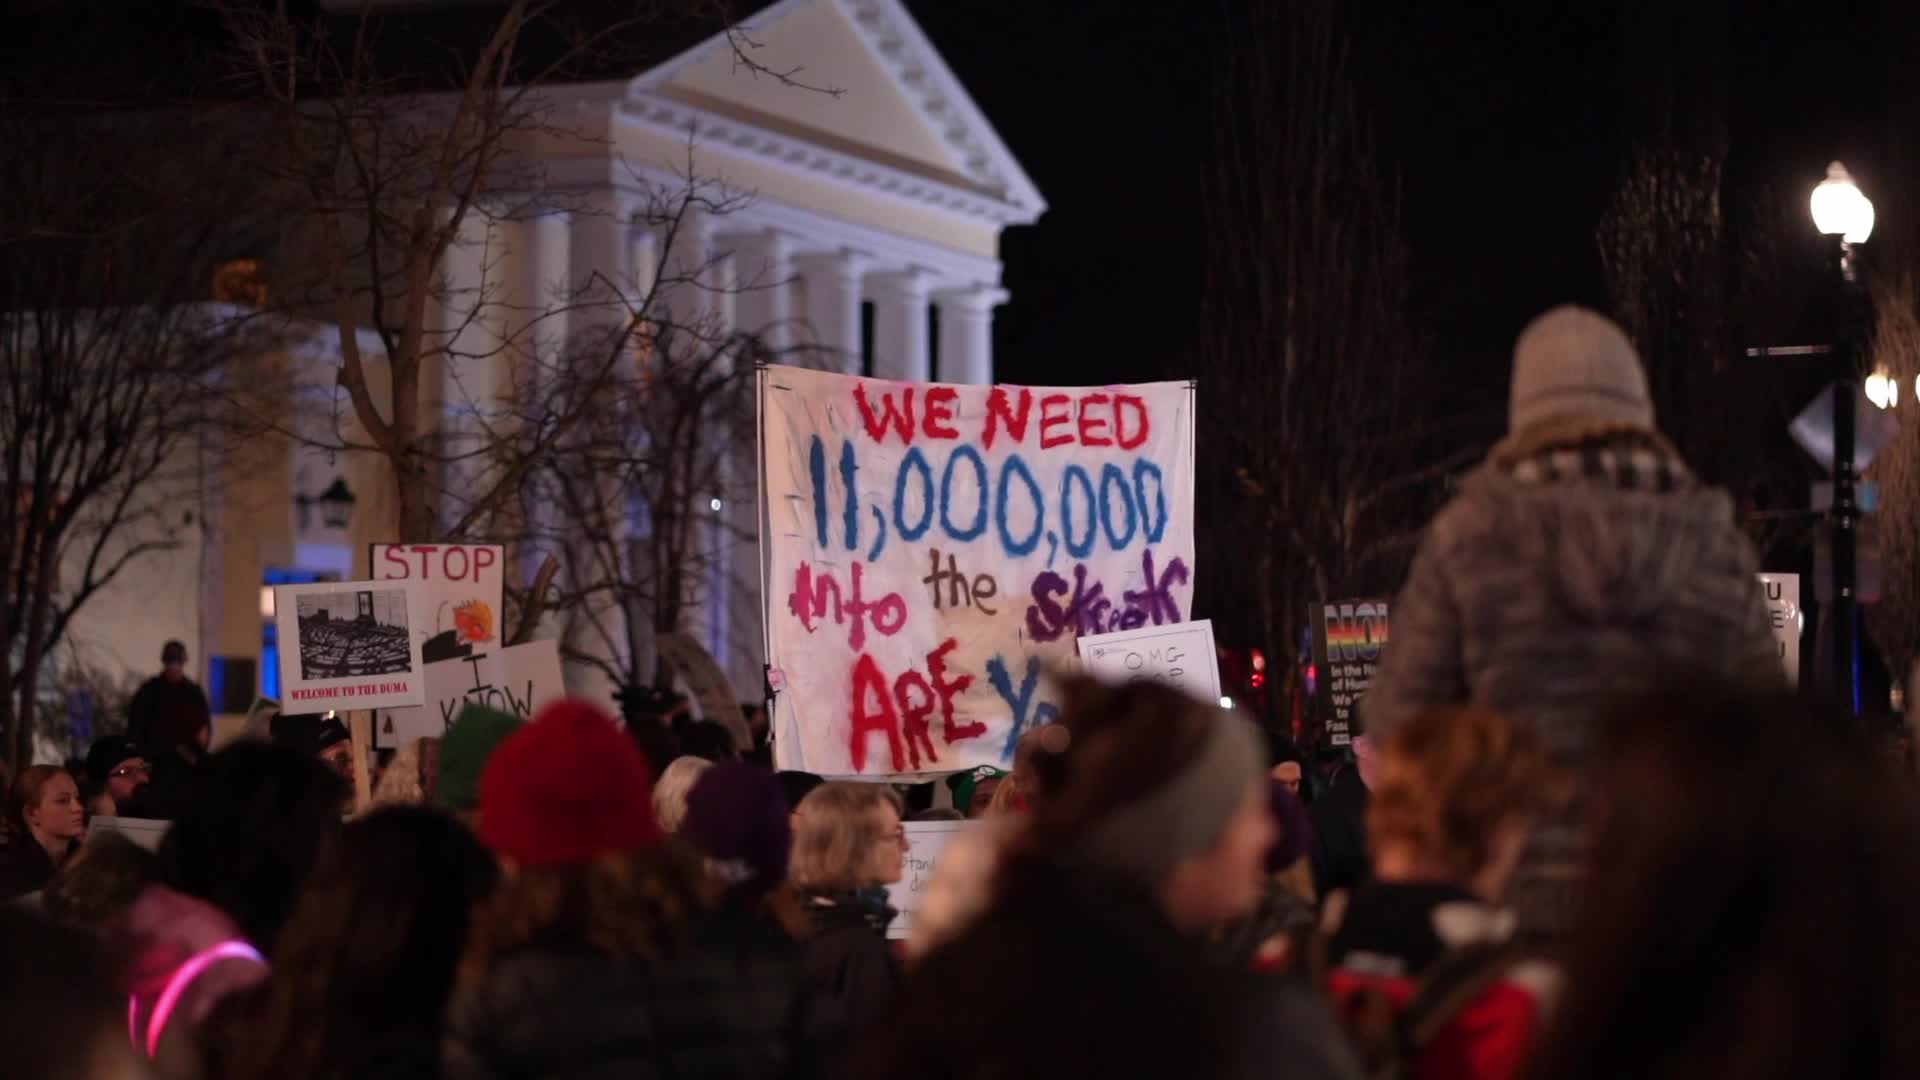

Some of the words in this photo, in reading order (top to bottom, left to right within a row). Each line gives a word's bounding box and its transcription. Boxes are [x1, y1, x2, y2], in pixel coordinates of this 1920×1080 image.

[853, 383, 960, 446] WE
[981, 386, 1149, 451] NEED
[809, 434, 1168, 569] 11,000,000
[385, 543, 494, 583] STOP
[924, 548, 998, 615] the
[462, 652, 493, 694] I
[1124, 646, 1185, 670] OMG
[291, 687, 339, 700] WELCOME
[342, 685, 355, 697] TO
[358, 684, 378, 696] THE
[380, 681, 408, 694] DUMA
[846, 637, 988, 773] ARE
[1336, 707, 1349, 719] to
